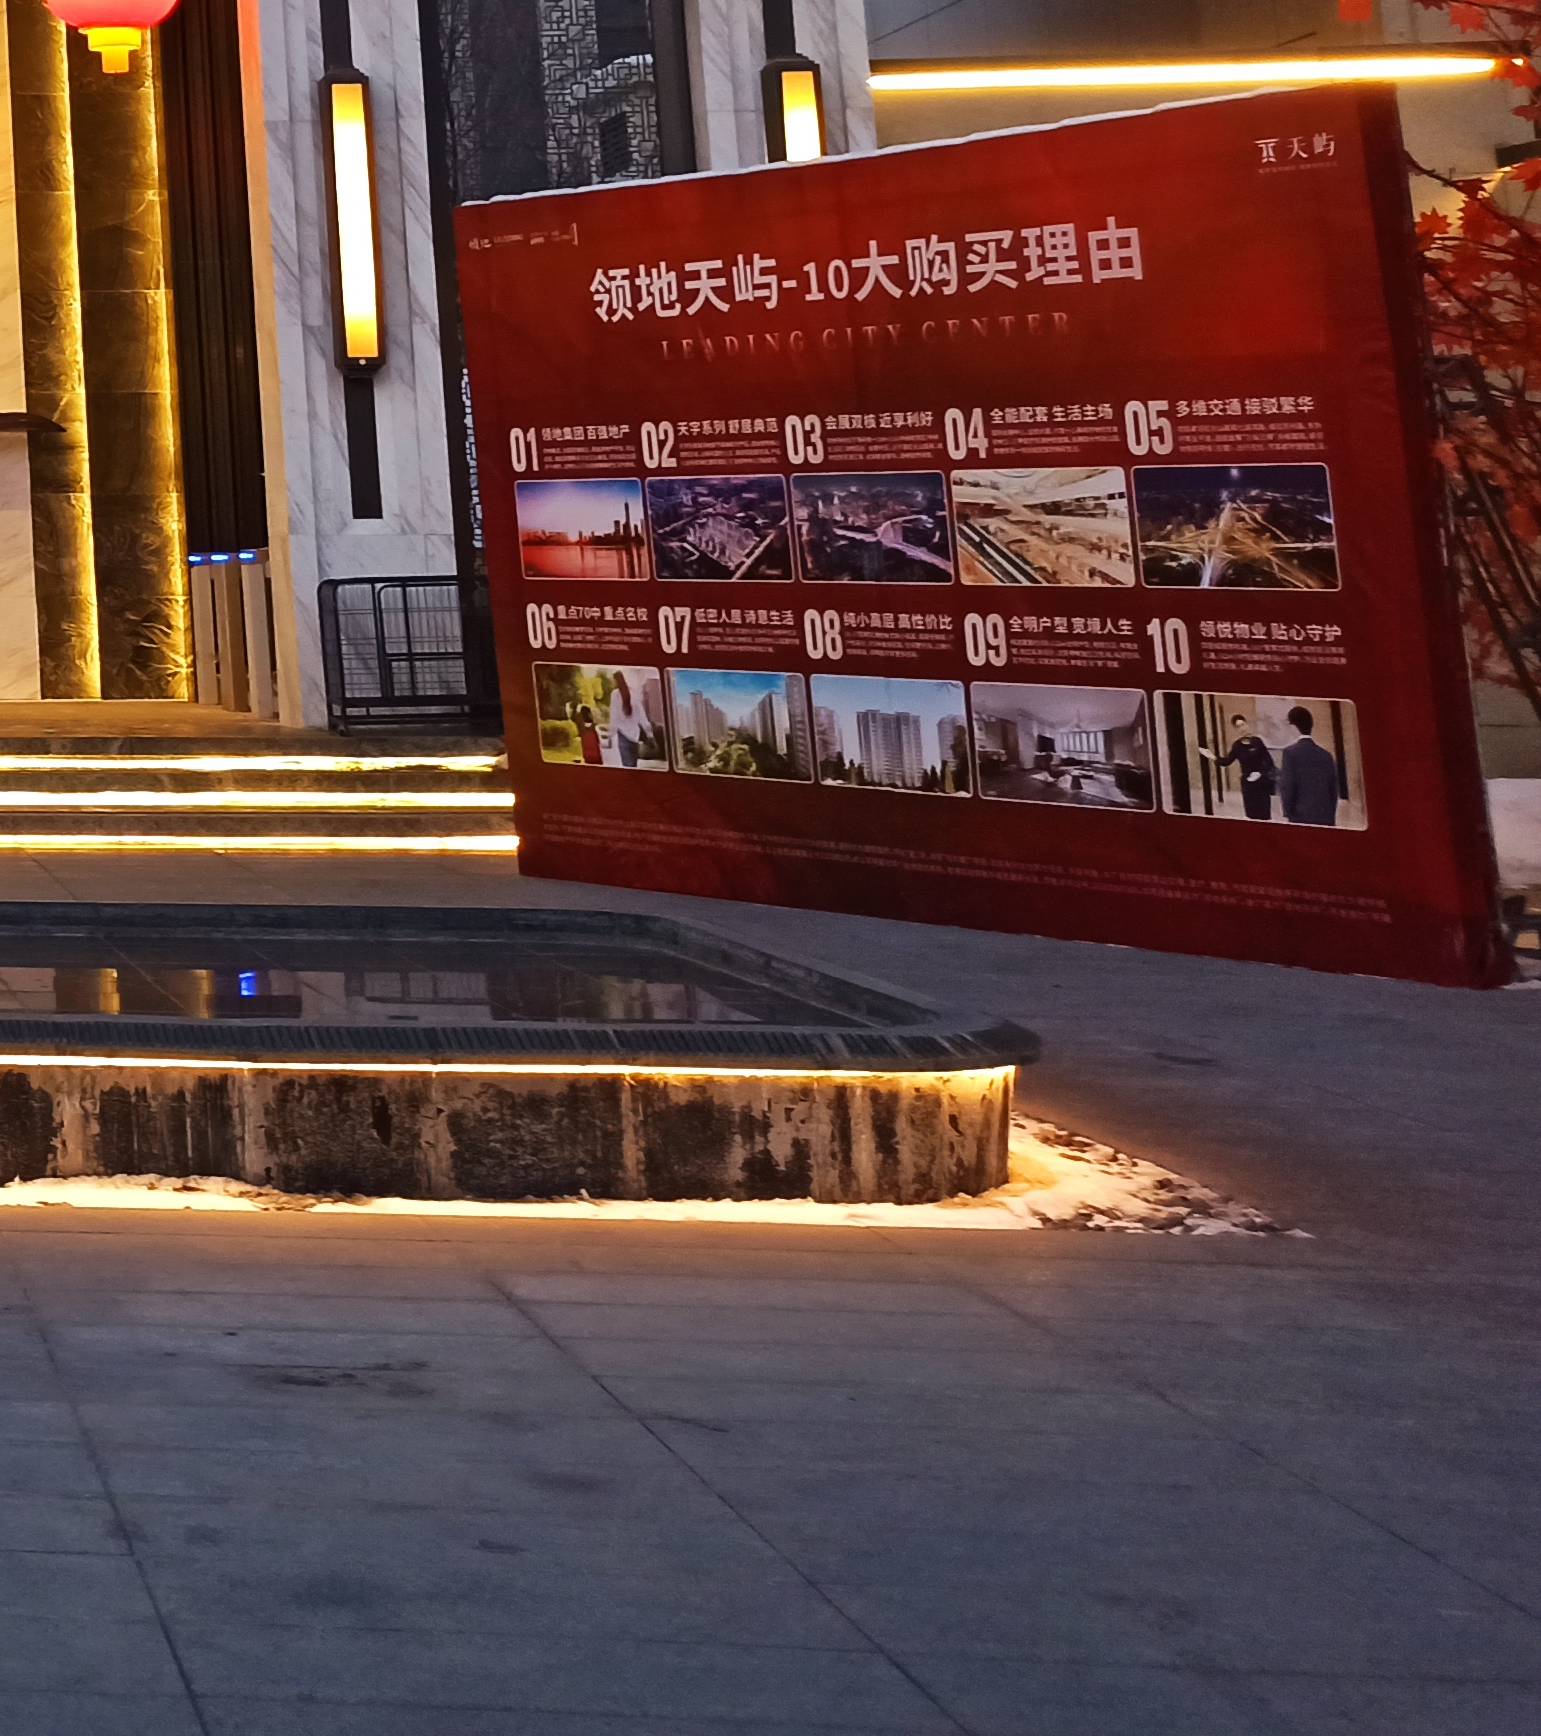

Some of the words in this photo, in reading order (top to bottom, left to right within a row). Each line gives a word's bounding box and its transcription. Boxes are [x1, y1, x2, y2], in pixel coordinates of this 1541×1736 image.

[1288, 133, 1334, 158] 天屿
[590, 216, 1144, 323] 领地天屿-10大购买理由
[661, 330, 804, 362] LEADING
[822, 322, 901, 350] CITY
[921, 311, 1070, 343] CENTER
[990, 407, 1047, 423] 全能配套
[1052, 404, 1113, 421] 生活主场
[1125, 401, 1172, 455] 05
[1176, 399, 1241, 417] 多维交通
[510, 428, 539, 472] 01
[641, 421, 677, 468] 02
[785, 415, 823, 464] 03
[945, 408, 988, 460] 04
[527, 603, 556, 648] 06
[557, 605, 601, 619] 重点70中
[604, 606, 647, 621] 重点名校
[659, 606, 691, 653] 07
[804, 609, 842, 659] 08
[844, 612, 894, 628] 纯小高层
[898, 614, 952, 629] 高性价比
[1009, 616, 1068, 633] 全明户型
[1200, 621, 1267, 639] 领悦物业
[1271, 623, 1341, 641] 贴心守护
[965, 613, 1006, 666] 09
[1147, 618, 1190, 674] 10
